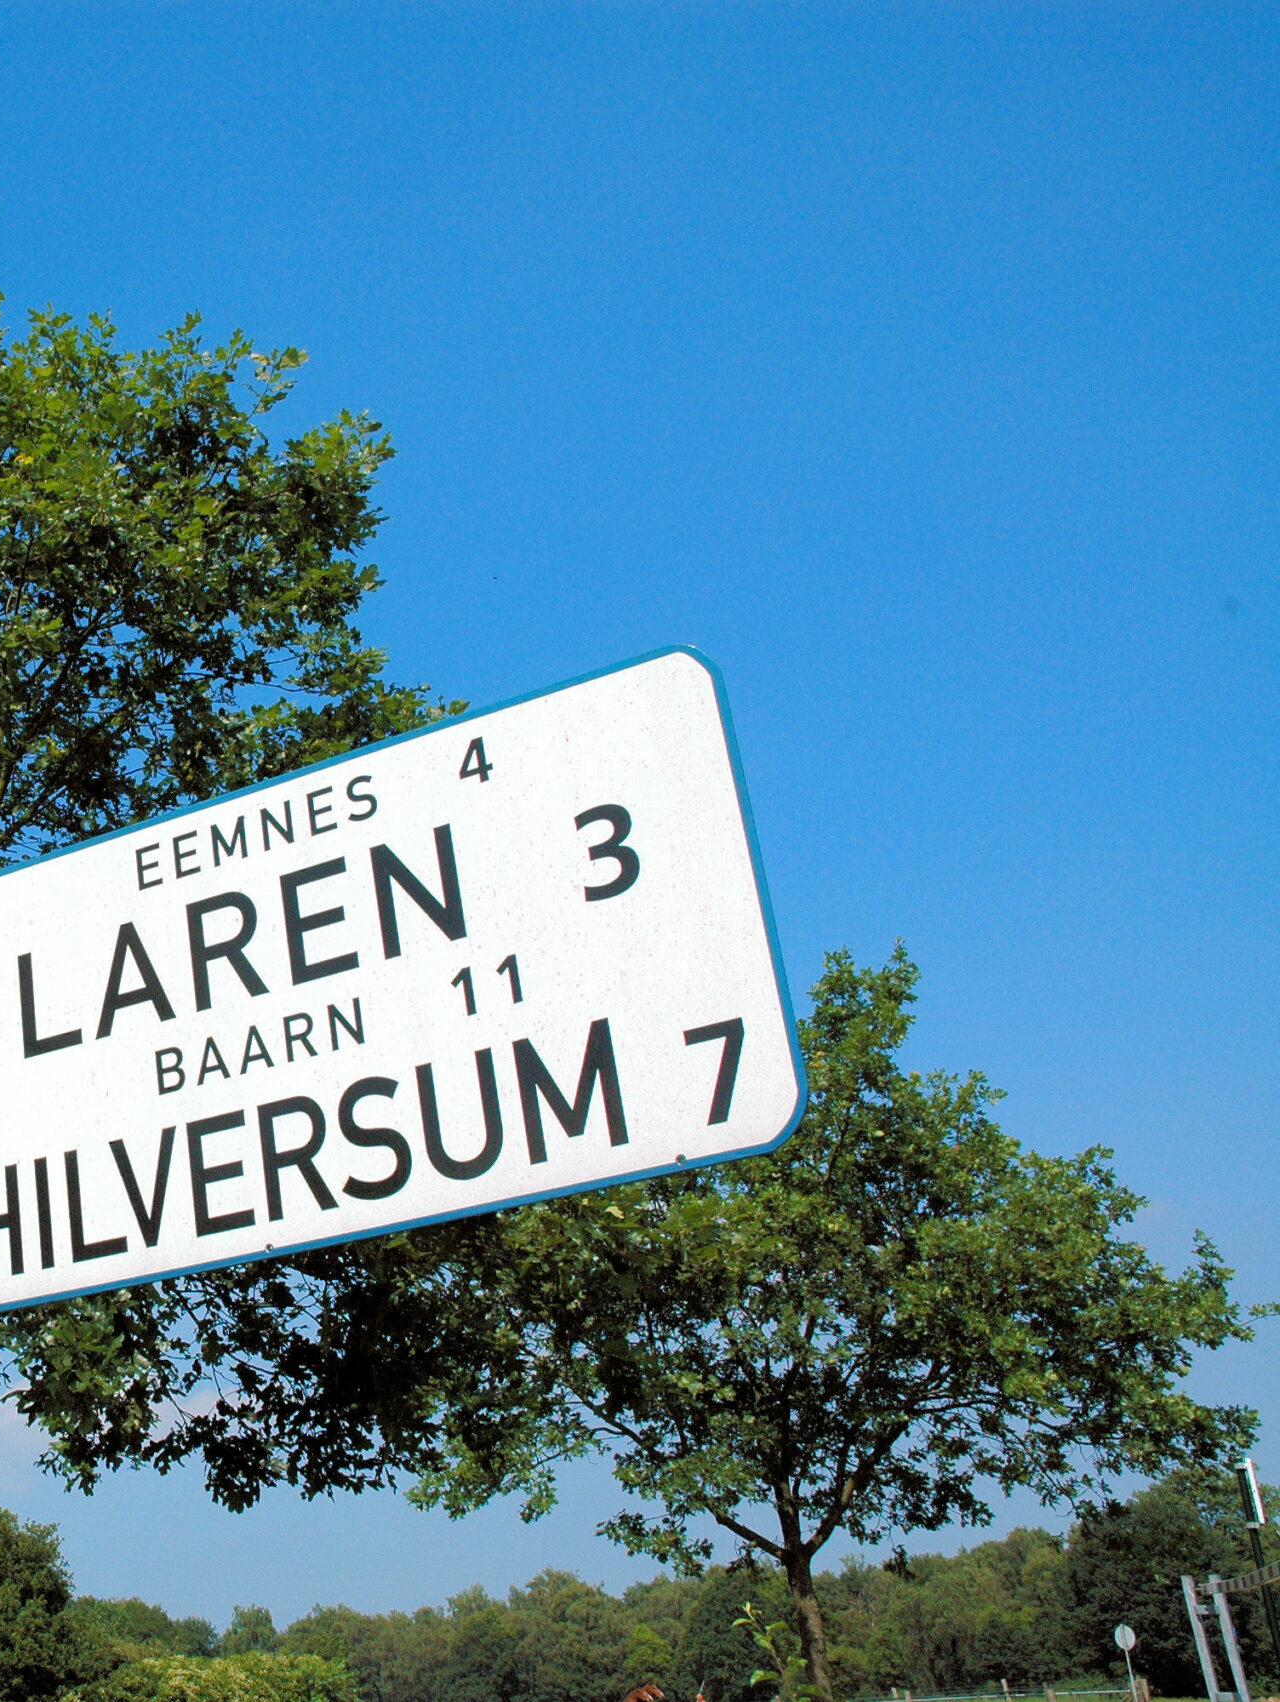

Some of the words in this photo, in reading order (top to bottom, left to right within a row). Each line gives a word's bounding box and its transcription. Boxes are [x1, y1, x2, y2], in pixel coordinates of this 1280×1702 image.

[135, 775, 377, 891] EEMNES
[460, 737, 493, 782] 4
[17, 823, 467, 1059] LAREN
[575, 804, 640, 902] 3
[155, 997, 365, 1095] BAARN
[452, 954, 523, 1016] 11
[684, 1017, 744, 1126] 7
